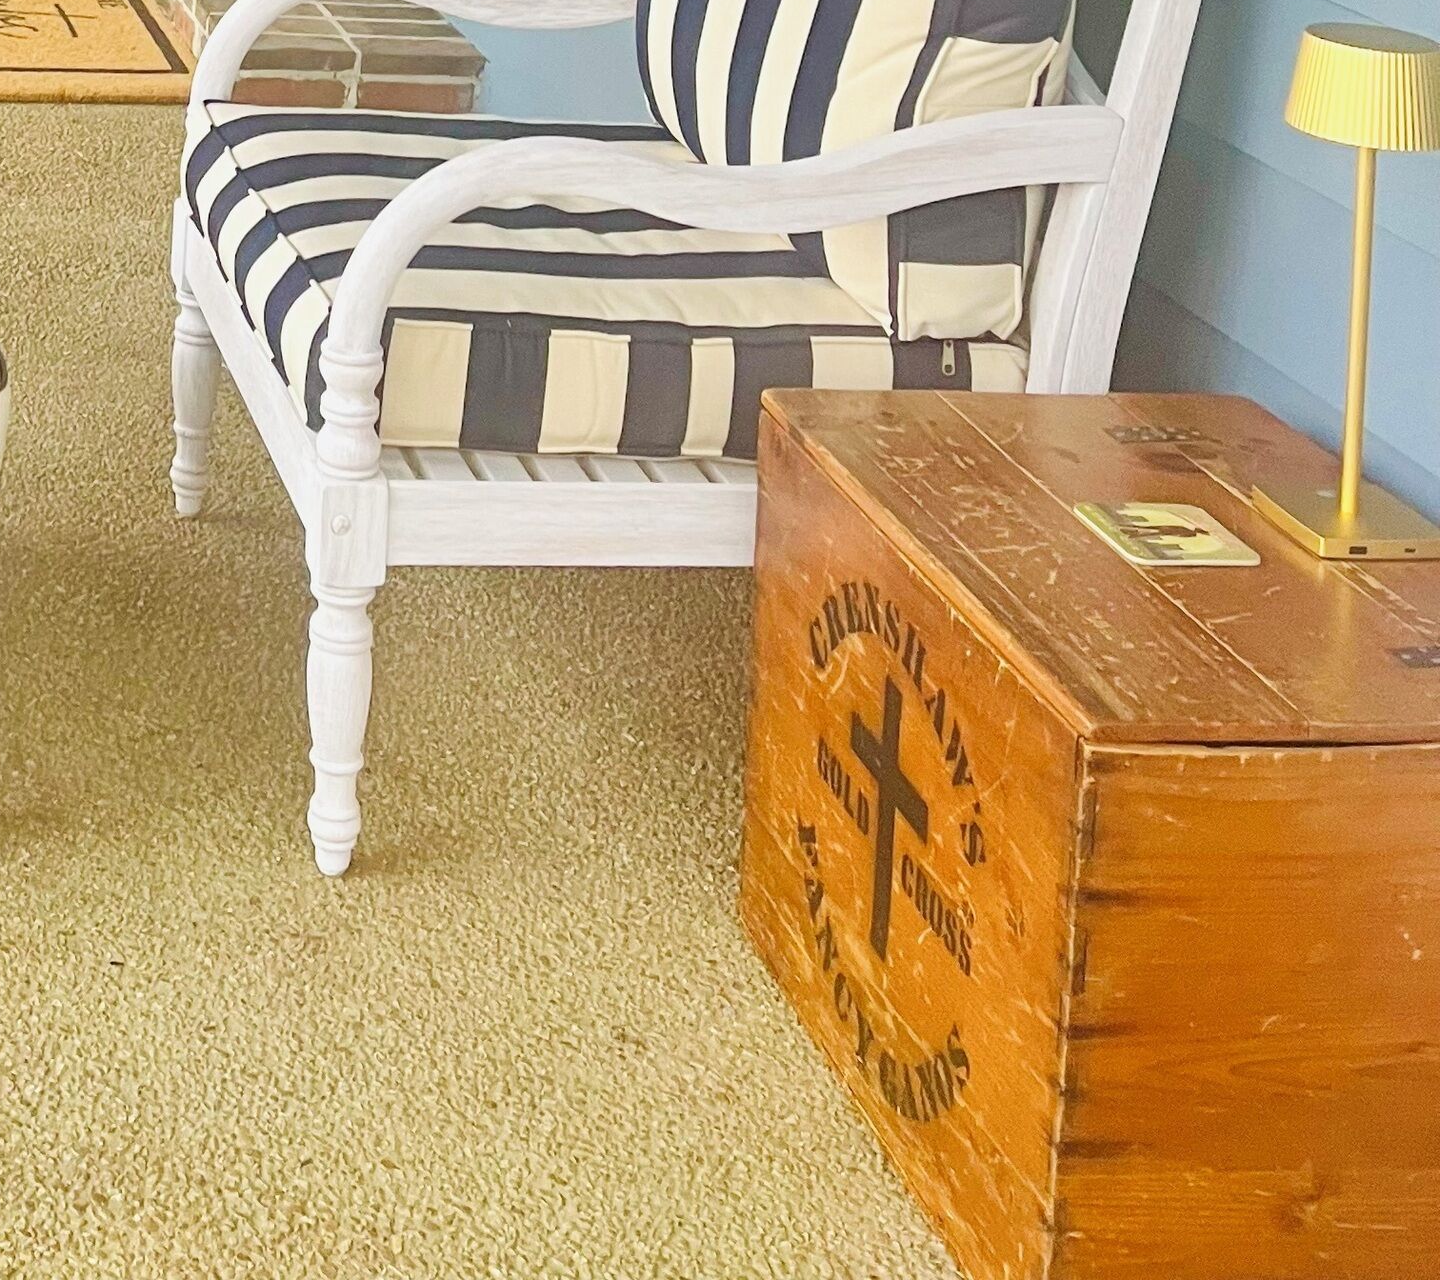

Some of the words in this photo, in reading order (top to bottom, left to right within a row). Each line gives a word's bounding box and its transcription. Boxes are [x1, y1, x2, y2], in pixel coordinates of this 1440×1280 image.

[809, 580, 986, 867] CRENSHAW'S
[816, 736, 870, 837] GOLD
[900, 853, 973, 977] CROSS
